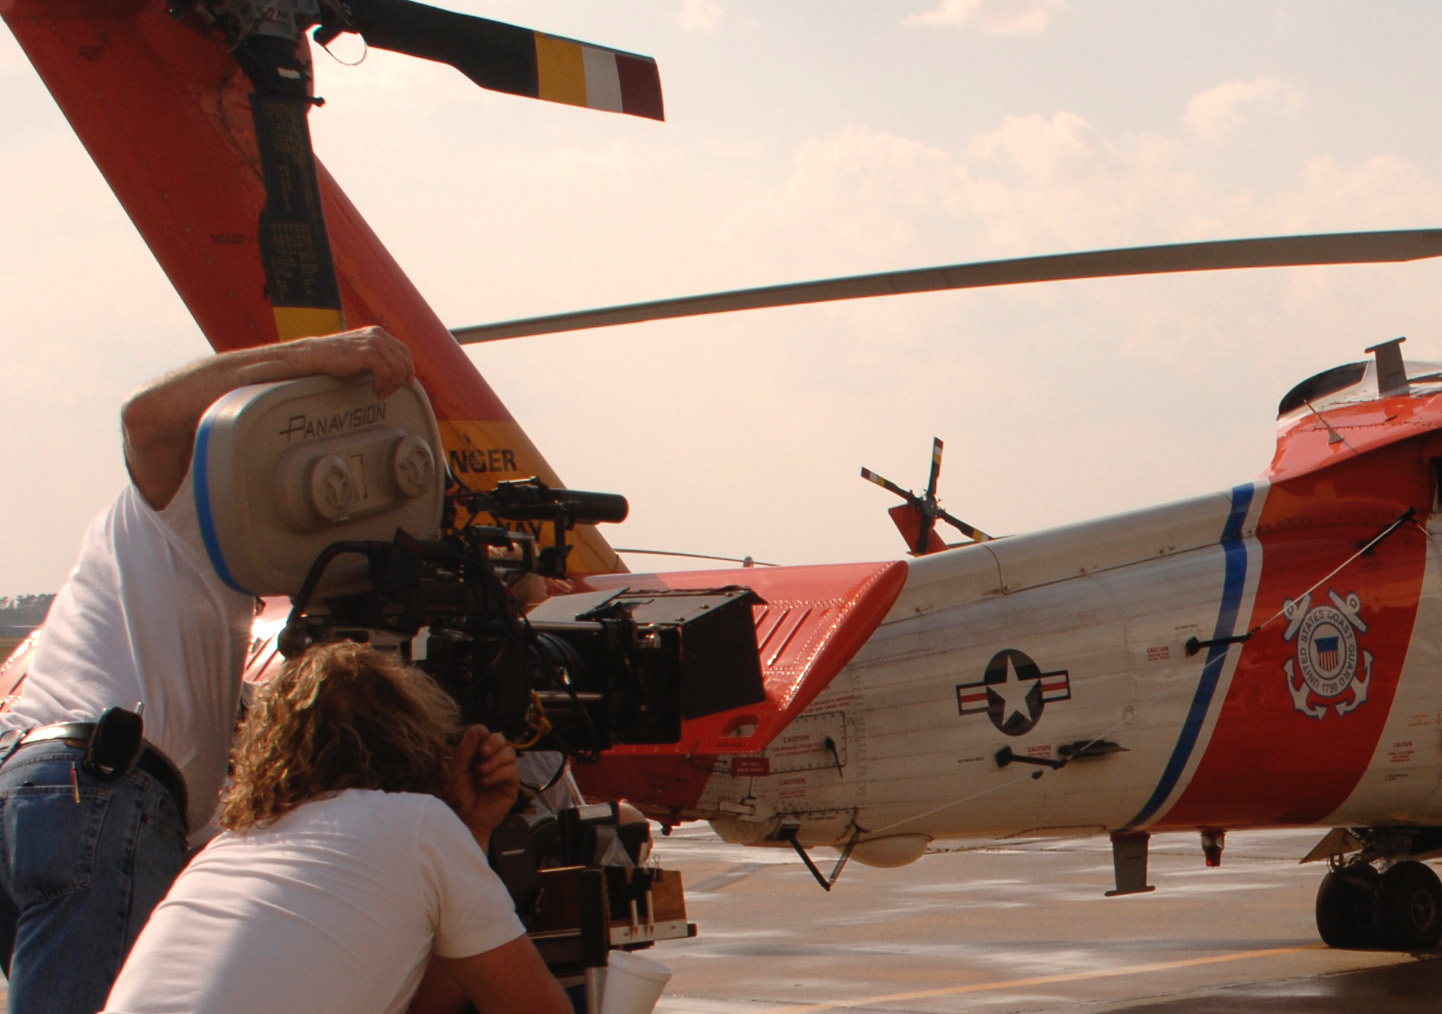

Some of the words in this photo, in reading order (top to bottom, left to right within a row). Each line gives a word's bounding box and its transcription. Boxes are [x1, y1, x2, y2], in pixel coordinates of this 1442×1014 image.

[279, 402, 387, 443] PANAVISION
[449, 448, 518, 473] NGER
[1301, 609, 1325, 643] STATES
[1327, 609, 1353, 640] COAST
[1300, 648, 1319, 689] UNITED
[1339, 645, 1356, 687] GUARD
[1322, 683, 1338, 694] 1790
